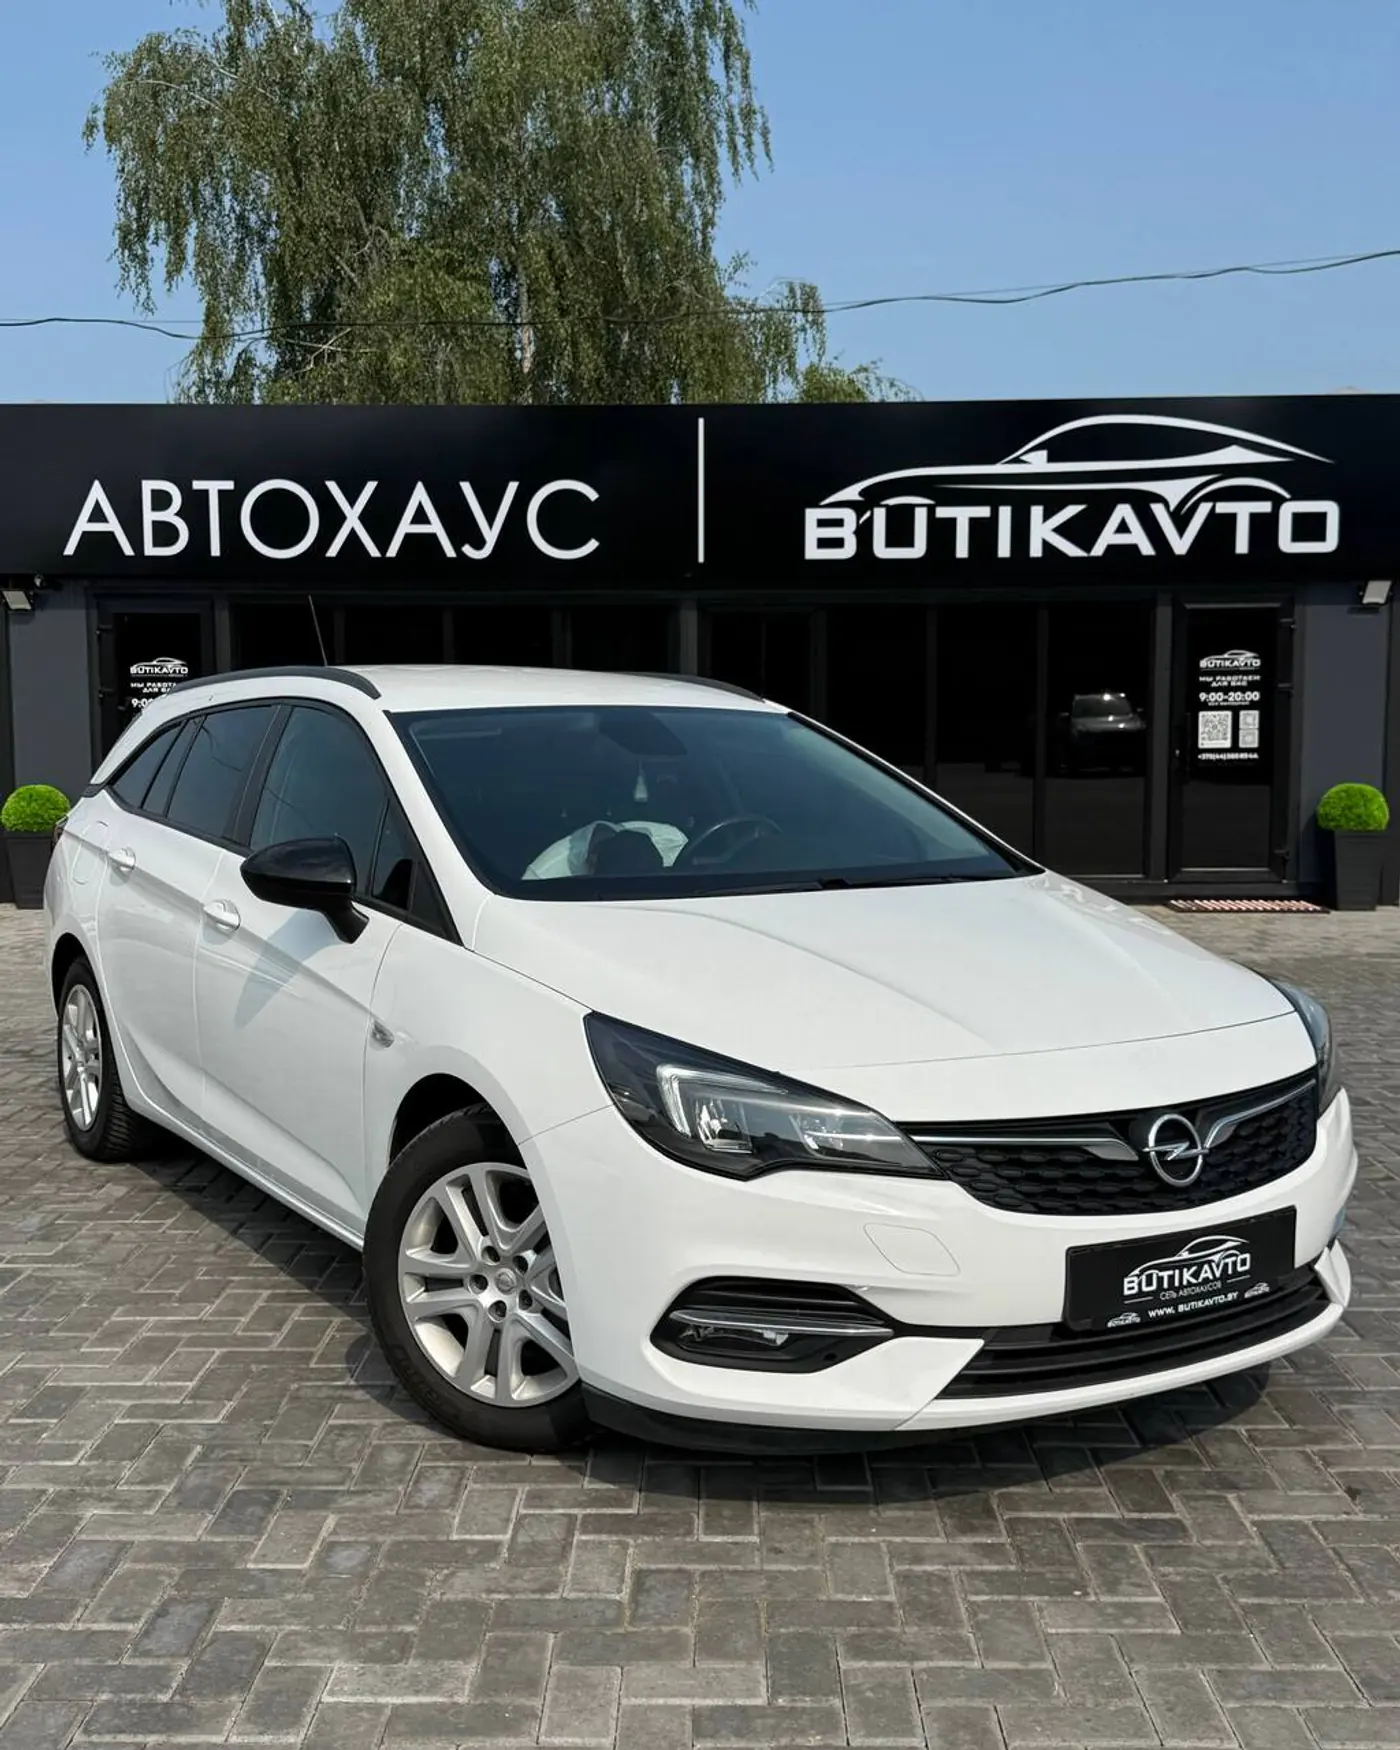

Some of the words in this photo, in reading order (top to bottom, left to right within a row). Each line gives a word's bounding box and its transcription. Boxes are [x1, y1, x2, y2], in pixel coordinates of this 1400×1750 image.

[63, 478, 600, 560] АВТОХАУС
[804, 499, 1341, 560] BUTIKAVTO
[1199, 659, 1261, 668] BUTIKAVTO
[130, 666, 188, 674] BUTIKAVTO
[1199, 692, 1260, 702] 9:00-20:00
[1123, 1253, 1251, 1295] BUTIKAVTO
[1148, 1306, 1175, 1318] WWW.
